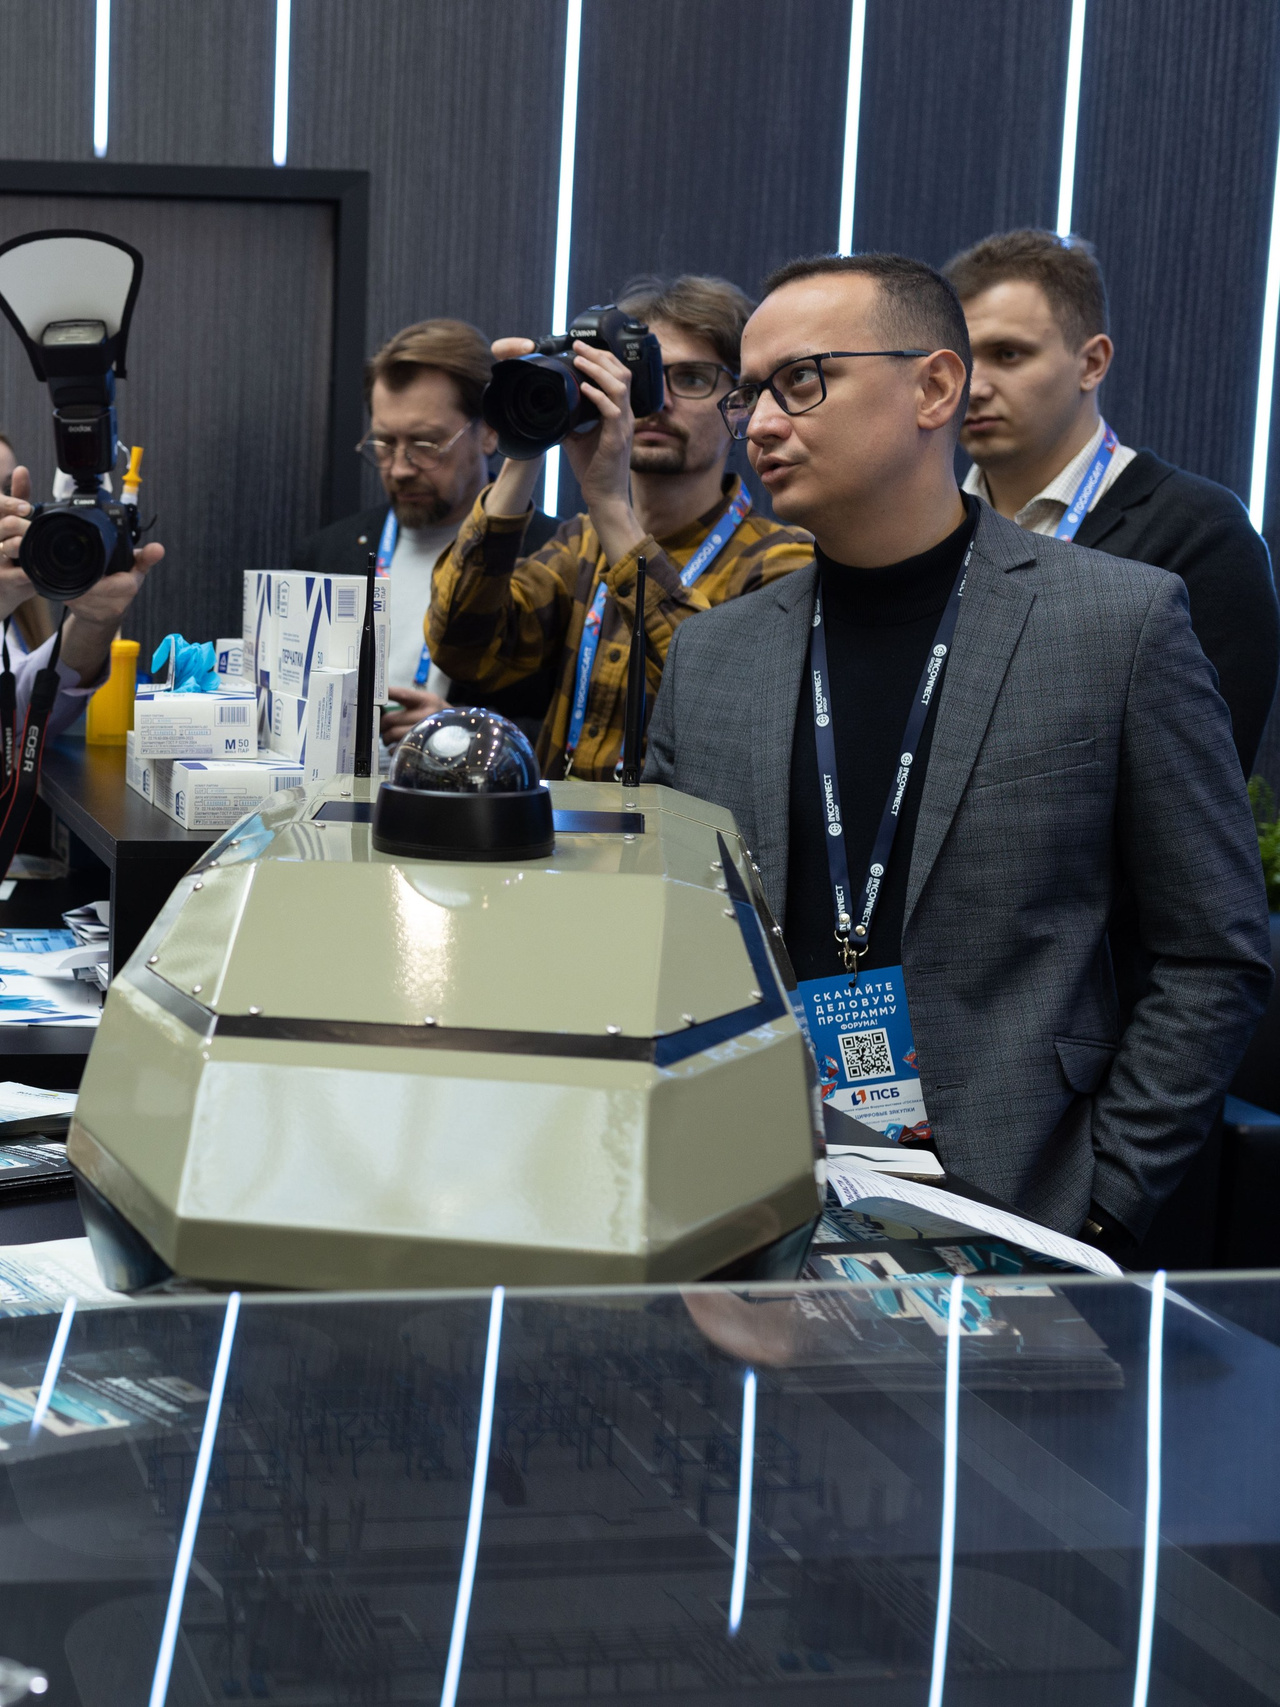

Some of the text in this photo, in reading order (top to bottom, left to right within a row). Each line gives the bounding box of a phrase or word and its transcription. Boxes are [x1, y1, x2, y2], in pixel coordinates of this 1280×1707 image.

[570, 328, 598, 338] Canon
[73, 498, 96, 506] Canon
[813, 670, 823, 714] INCONNECT
[921, 657, 943, 706] INCONNECT
[23, 725, 39, 772] EOS R
[225, 739, 249, 750] M 50
[824, 773, 835, 822] INCONNECT
[891, 766, 910, 817] INCONNECT
[861, 878, 880, 927] INCONNECT
[813, 982, 893, 1003] СКАЧАЙТЕ
[815, 994, 895, 1016] ДЕЛОВУЮ
[818, 1005, 897, 1026] ПРОГРАММУ
[840, 1019, 878, 1030] ФОРУМА!
[869, 1087, 900, 1101] ПСБ
